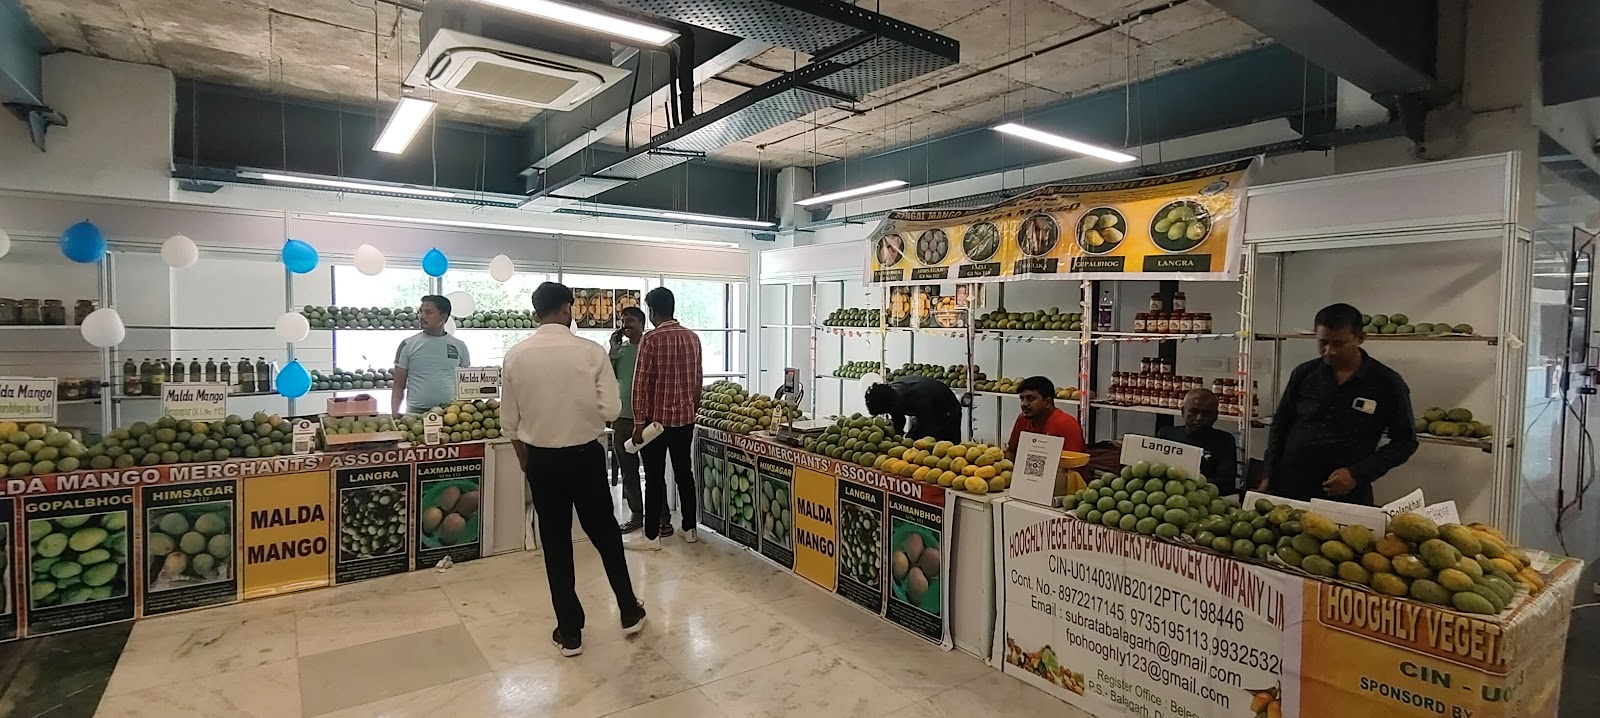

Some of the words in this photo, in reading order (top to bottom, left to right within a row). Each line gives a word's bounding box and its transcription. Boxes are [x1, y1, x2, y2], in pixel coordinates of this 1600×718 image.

[1140, 175, 1179, 187] EXPO
[927, 211, 962, 220] MANGO
[460, 372, 480, 384] Malda
[0, 384, 14, 398] da
[18, 384, 52, 402] Mango
[166, 389, 194, 402] Malda
[196, 389, 224, 404] Mango
[1141, 438, 1184, 456] Langra
[56, 468, 160, 492] MANGO
[330, 446, 460, 468] ASSOCIATION
[418, 464, 482, 476] LAXMANBHOG
[708, 428, 733, 444] MALDA
[734, 436, 766, 454] MANGO
[834, 462, 922, 499] ASSOCIATION
[760, 461, 792, 478] HIMSAGAR
[349, 470, 399, 483] LANGRA
[26, 494, 133, 513] GOPALBHOG
[152, 485, 234, 501] HIMSAGAR
[844, 486, 876, 504] LANGRA
[250, 504, 325, 530] MALDA
[797, 497, 833, 526] MALDA
[889, 500, 942, 524] LAXMANBHOG
[247, 536, 327, 565] MANGO
[796, 528, 834, 558] MANGO
[1009, 520, 1045, 559] HOOGHLY
[1046, 518, 1093, 551] VEGETABLE
[1096, 526, 1142, 561] GROWERS
[1144, 540, 1202, 584] PRODUCER
[1205, 554, 1264, 616] COMPANY
[1011, 569, 1034, 590] Cont.
[1048, 554, 1244, 632] CIN-U01403WB2012PTC198446
[1328, 584, 1420, 642] HOOGHLY
[1065, 608, 1242, 688] subratabalagarh@gmail.com
[1066, 628, 1230, 709] fpohooghly123@gmail.com
[1399, 661, 1450, 689] CIN
[1097, 668, 1132, 693] Register
[1134, 685, 1162, 706] Office
[1360, 676, 1446, 714] SPONSORD
[1452, 705, 1474, 718] BY
